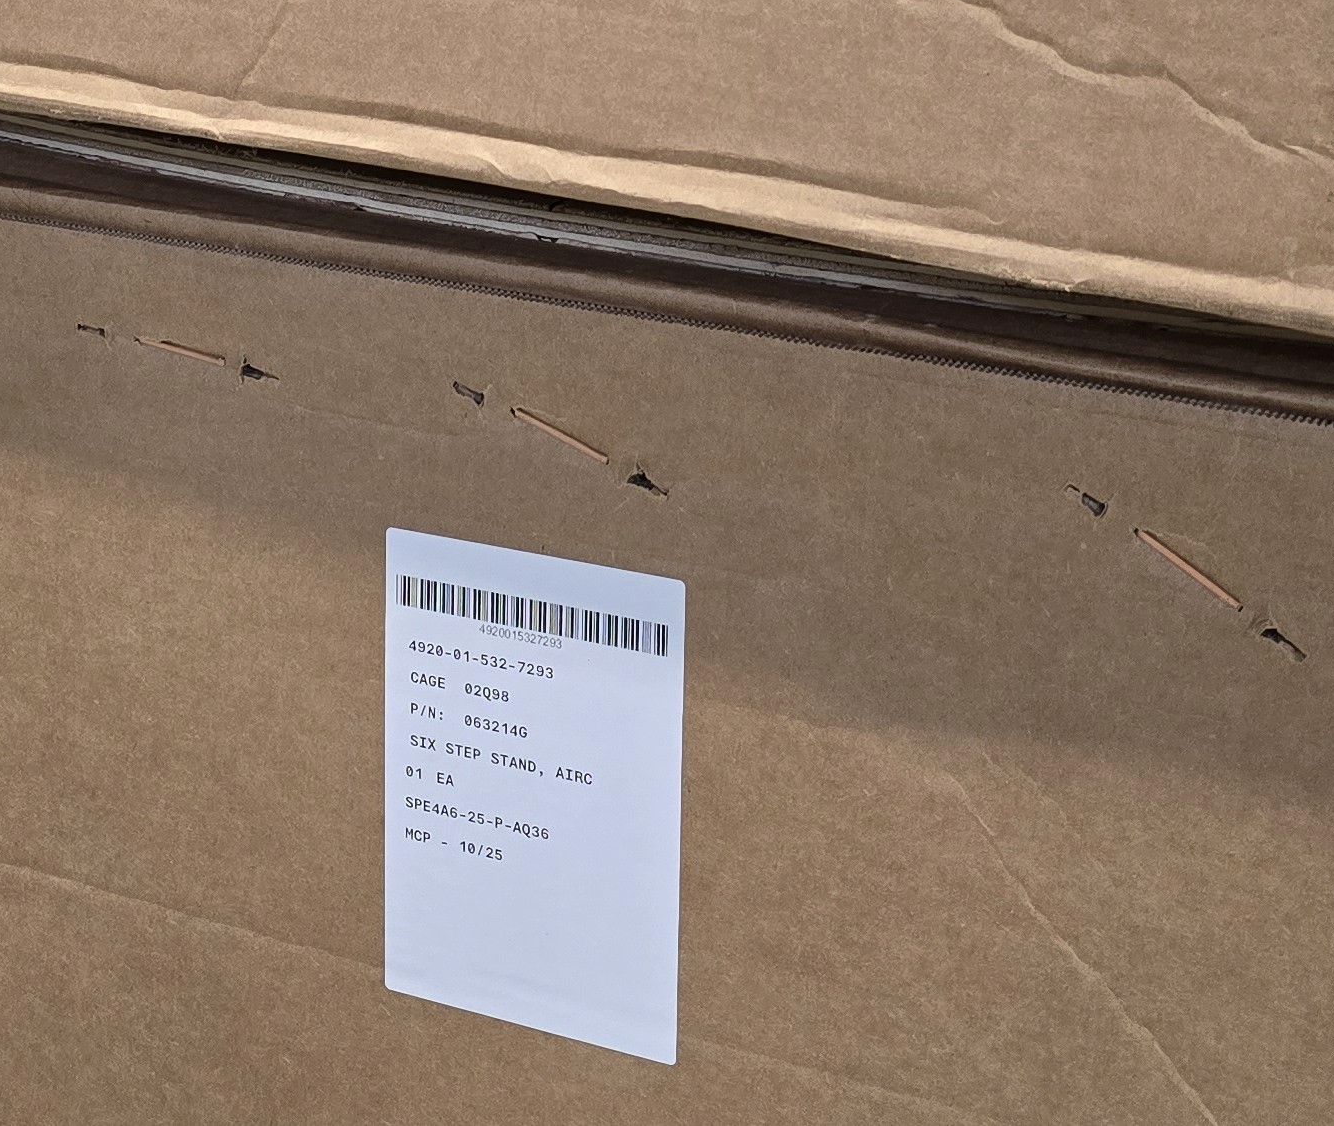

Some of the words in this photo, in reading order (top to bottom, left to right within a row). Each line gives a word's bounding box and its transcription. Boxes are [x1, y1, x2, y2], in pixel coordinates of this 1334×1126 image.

[479, 624, 563, 649] 4920015327293
[409, 640, 554, 679] 4920-01-532-7293
[410, 672, 446, 689] CAGE
[465, 683, 510, 702] 02Q98
[410, 703, 444, 720] P/N:
[464, 715, 528, 738] 063214G
[406, 766, 422, 779] 01
[437, 773, 454, 786] EA
[410, 735, 436, 751] SIX
[446, 743, 481, 759] STEP
[491, 753, 543, 777] STAND,
[556, 768, 593, 785] AIRC
[406, 797, 549, 840] SPE4A6-25-P-AQ36
[406, 827, 431, 842] MCP
[460, 841, 503, 861] 10/25
